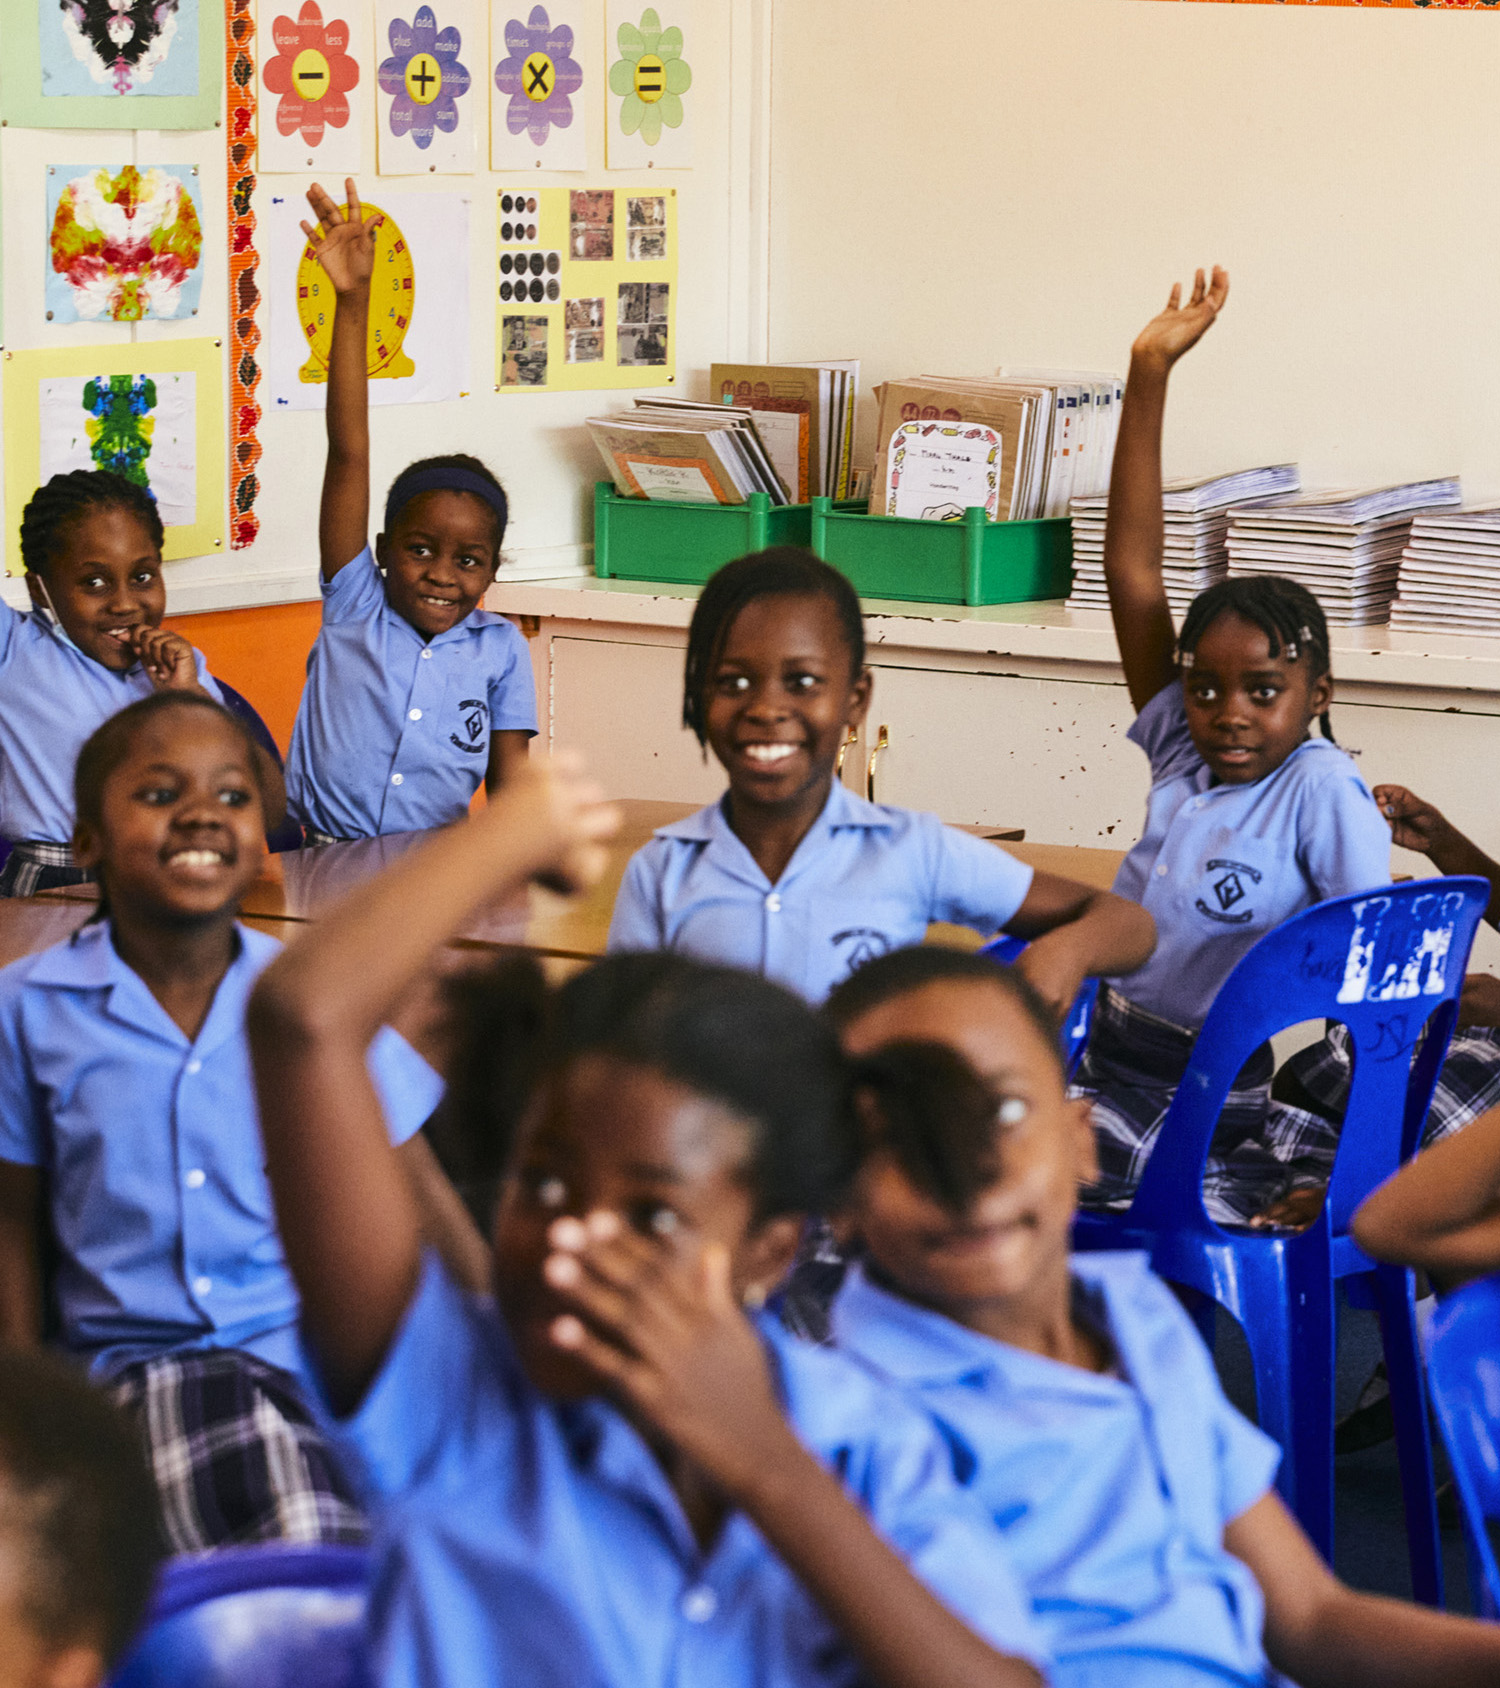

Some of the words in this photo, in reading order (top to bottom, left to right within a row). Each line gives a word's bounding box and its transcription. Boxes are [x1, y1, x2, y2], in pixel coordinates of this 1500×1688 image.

[416, 16, 433, 28] add
[275, 32, 300, 45] leave
[325, 33, 342, 46] less
[393, 34, 411, 50] plus
[507, 36, 529, 48] times
[435, 40, 458, 52] make
[392, 109, 412, 121] total
[436, 111, 455, 120] sum
[410, 127, 433, 137] more
[387, 250, 395, 263] 2
[312, 284, 319, 297] 9
[392, 279, 399, 291] 3
[318, 313, 325, 325] 8
[388, 307, 395, 319] 4
[375, 330, 382, 342] 5
